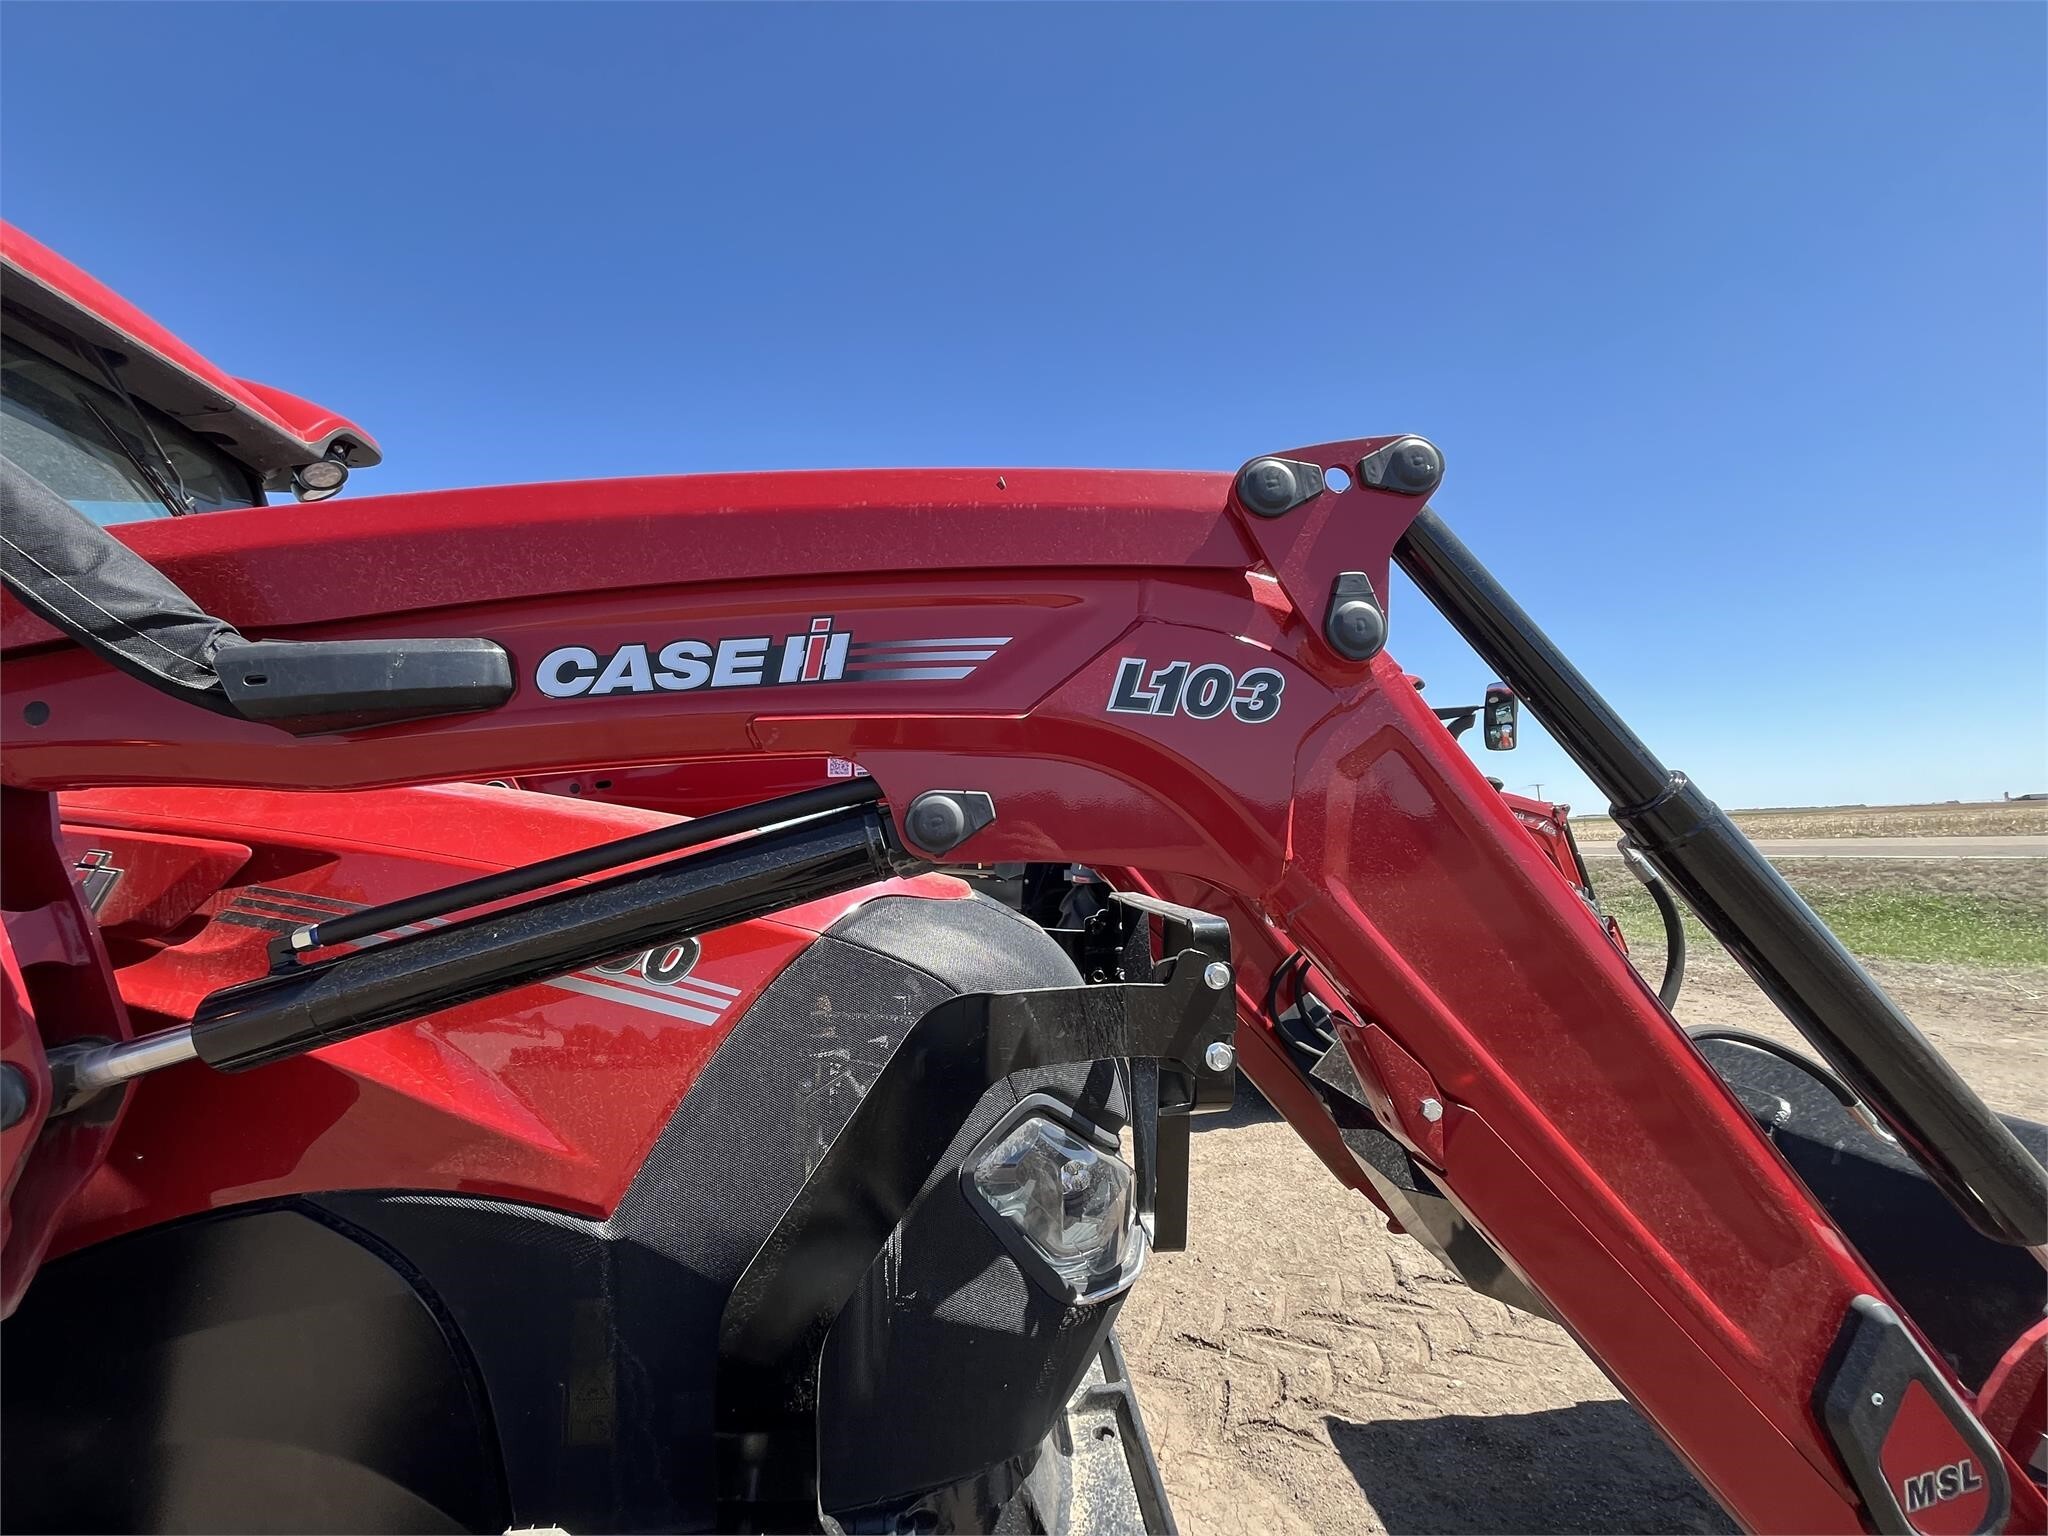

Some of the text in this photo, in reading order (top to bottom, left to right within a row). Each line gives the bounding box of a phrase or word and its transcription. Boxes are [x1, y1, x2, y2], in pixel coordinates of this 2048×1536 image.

[535, 636, 772, 698] CASE
[1106, 657, 1285, 723] L103
[1904, 1459, 1983, 1512] MSL
